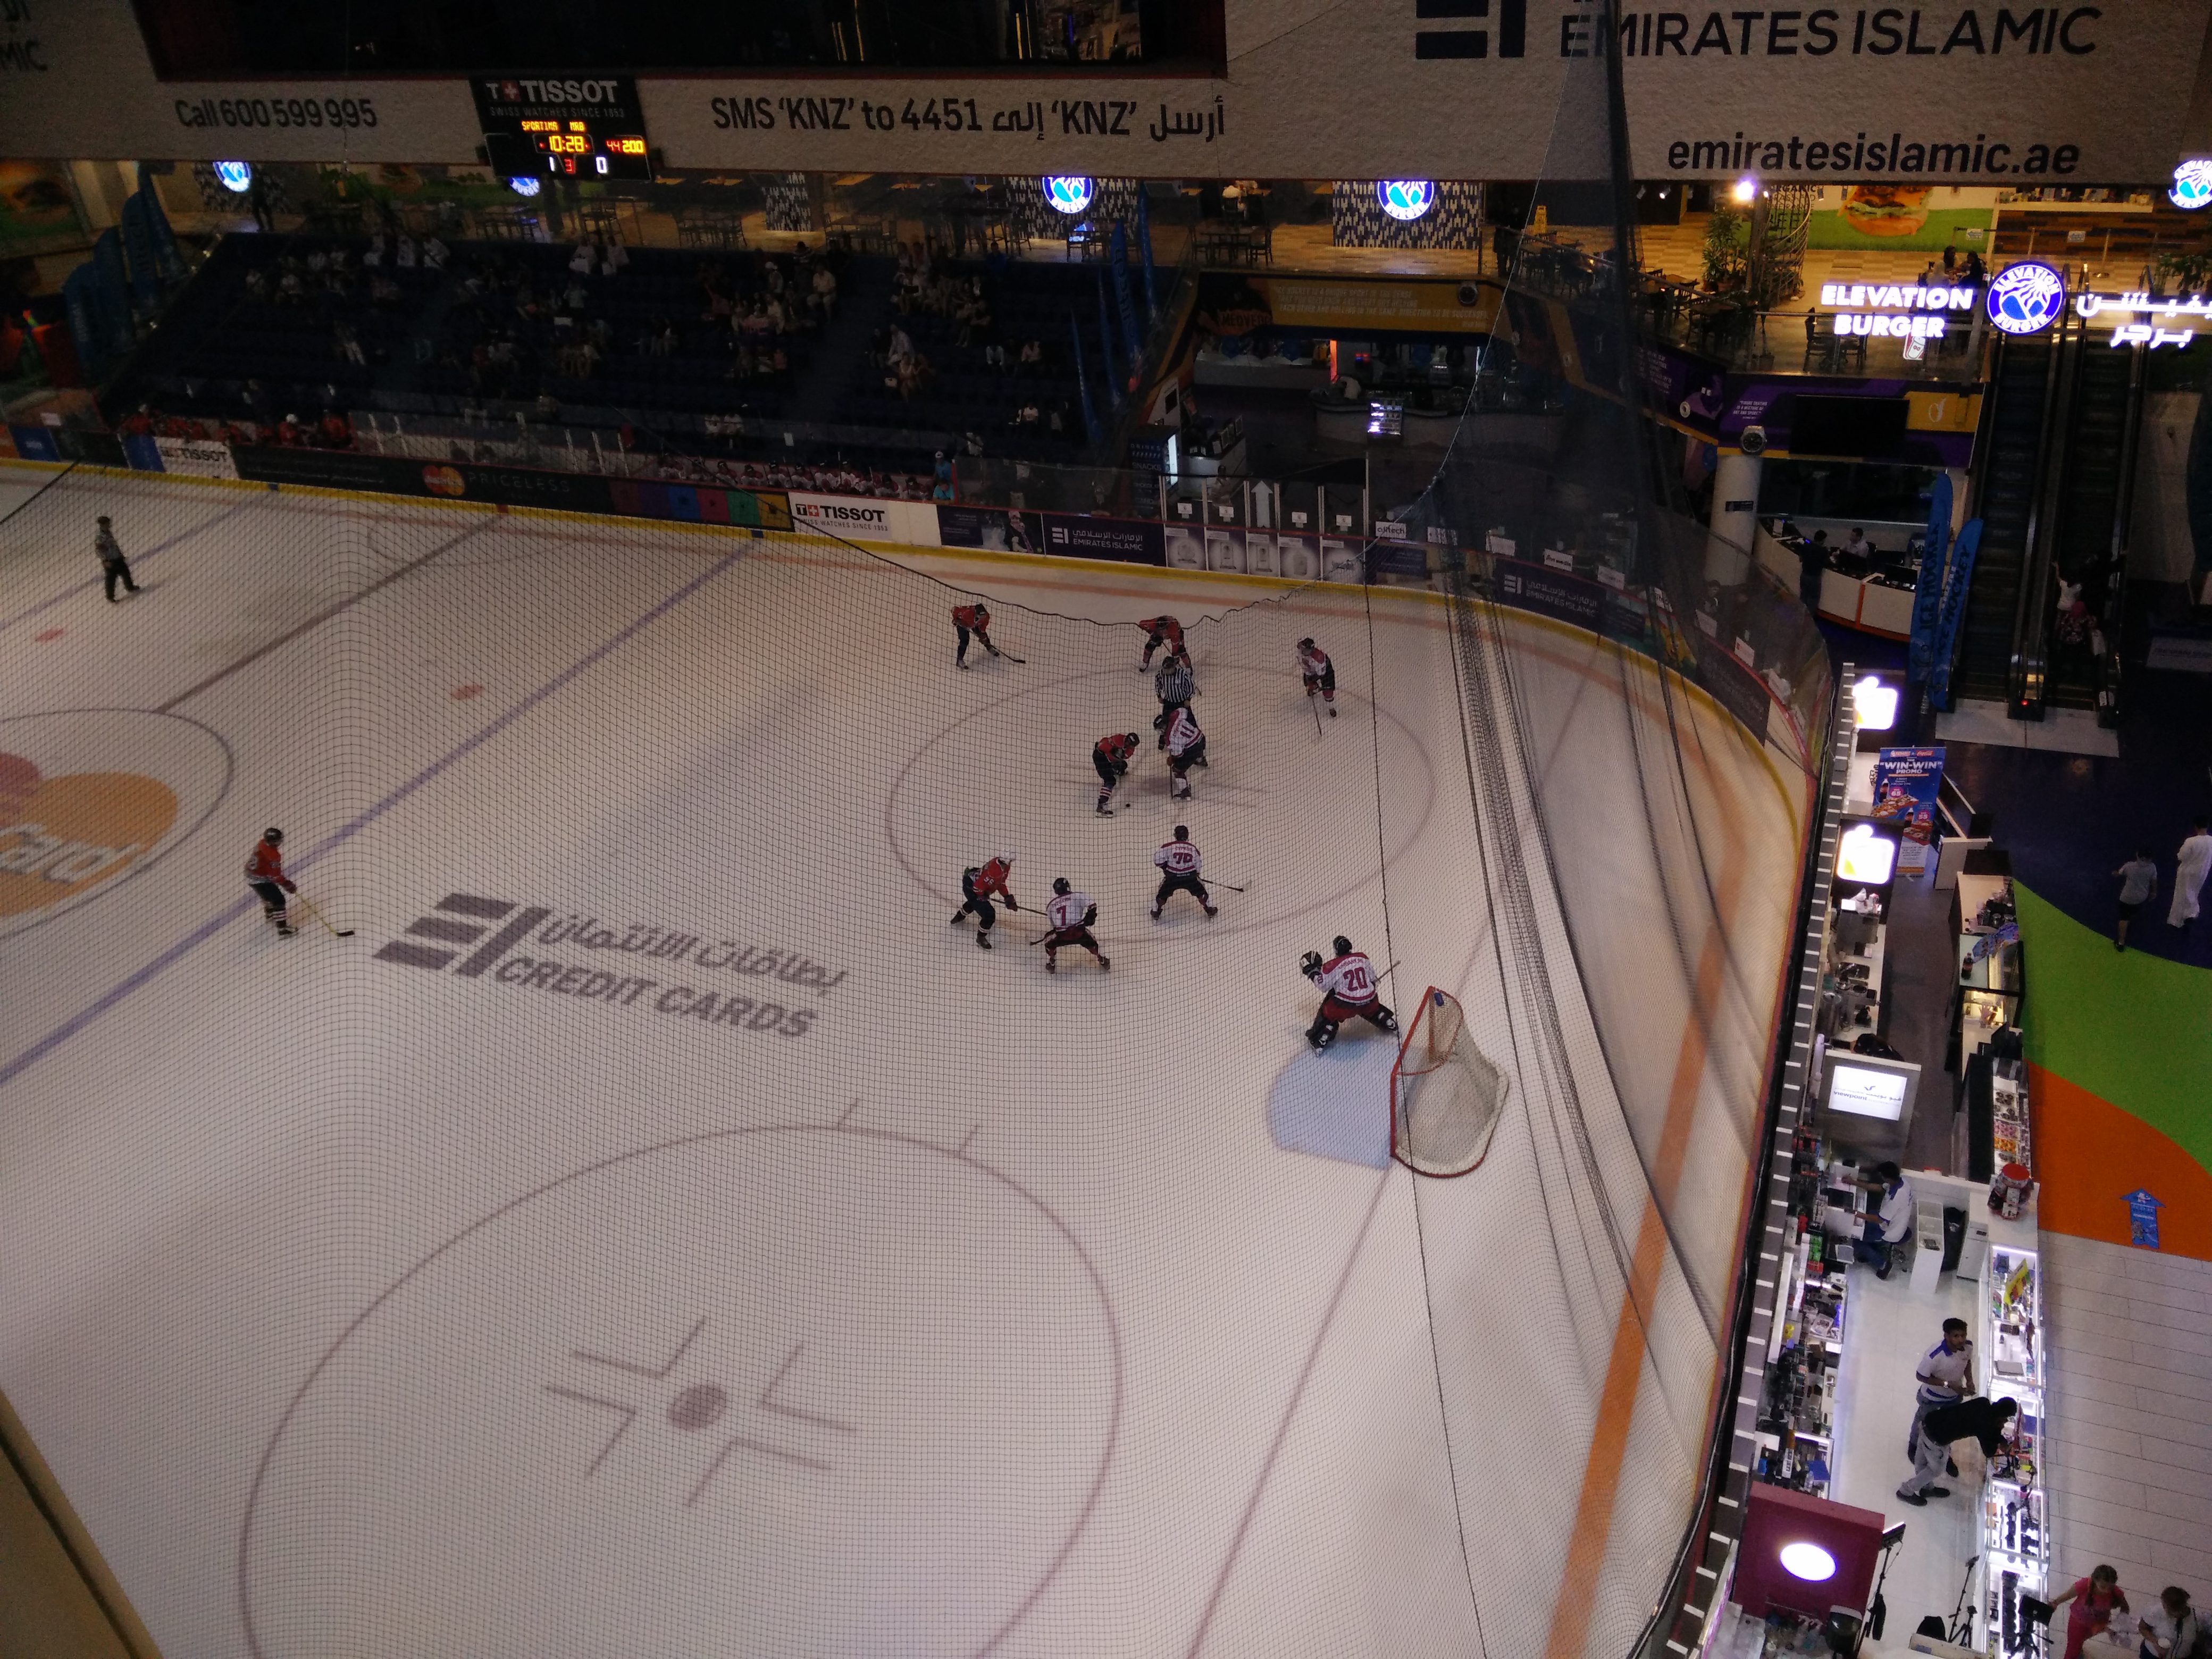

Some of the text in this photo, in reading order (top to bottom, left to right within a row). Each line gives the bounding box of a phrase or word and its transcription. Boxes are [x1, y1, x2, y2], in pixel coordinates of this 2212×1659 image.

[1561, 7, 2103, 57] EMIRATES ISLAMIC
[520, 80, 617, 103] TISSOT
[175, 98, 376, 128] Call 600 599 995
[489, 107, 625, 118] SWISS WATCHES SINCE 1853
[711, 97, 983, 131] SMS 'KNZ' to 4451
[993, 95, 1225, 142] أرسل 'KNZ' إلى
[548, 135, 584, 153] 10:28
[606, 140, 621, 152] 44
[1668, 131, 2079, 174] emiratesislamic.ae
[564, 158, 574, 173] 3
[595, 156, 608, 174] 0
[1993, 267, 2061, 295] ELEVATION
[1821, 284, 1974, 309] ELEVATION
[1834, 314, 1946, 338] BURGER
[1993, 313, 2050, 332] BURGER
[2110, 324, 2193, 349] برجر
[1132, 462, 1162, 471] SNACKS
[467, 472, 569, 492] PRICELESS
[820, 506, 885, 523] TISSOT
[1073, 538, 1143, 551] EMIRATES ISLAMIC
[1943, 544, 1971, 624] HOCKEY
[1526, 590, 1564, 607] EMIRATES
[1880, 761, 1942, 770] "WIN-WIN"
[1057, 905, 1066, 926] 7
[1343, 967, 1368, 992] 20
[495, 957, 818, 1037] CREDIT CARDS
[1833, 1091, 1867, 1101] viewpoint
